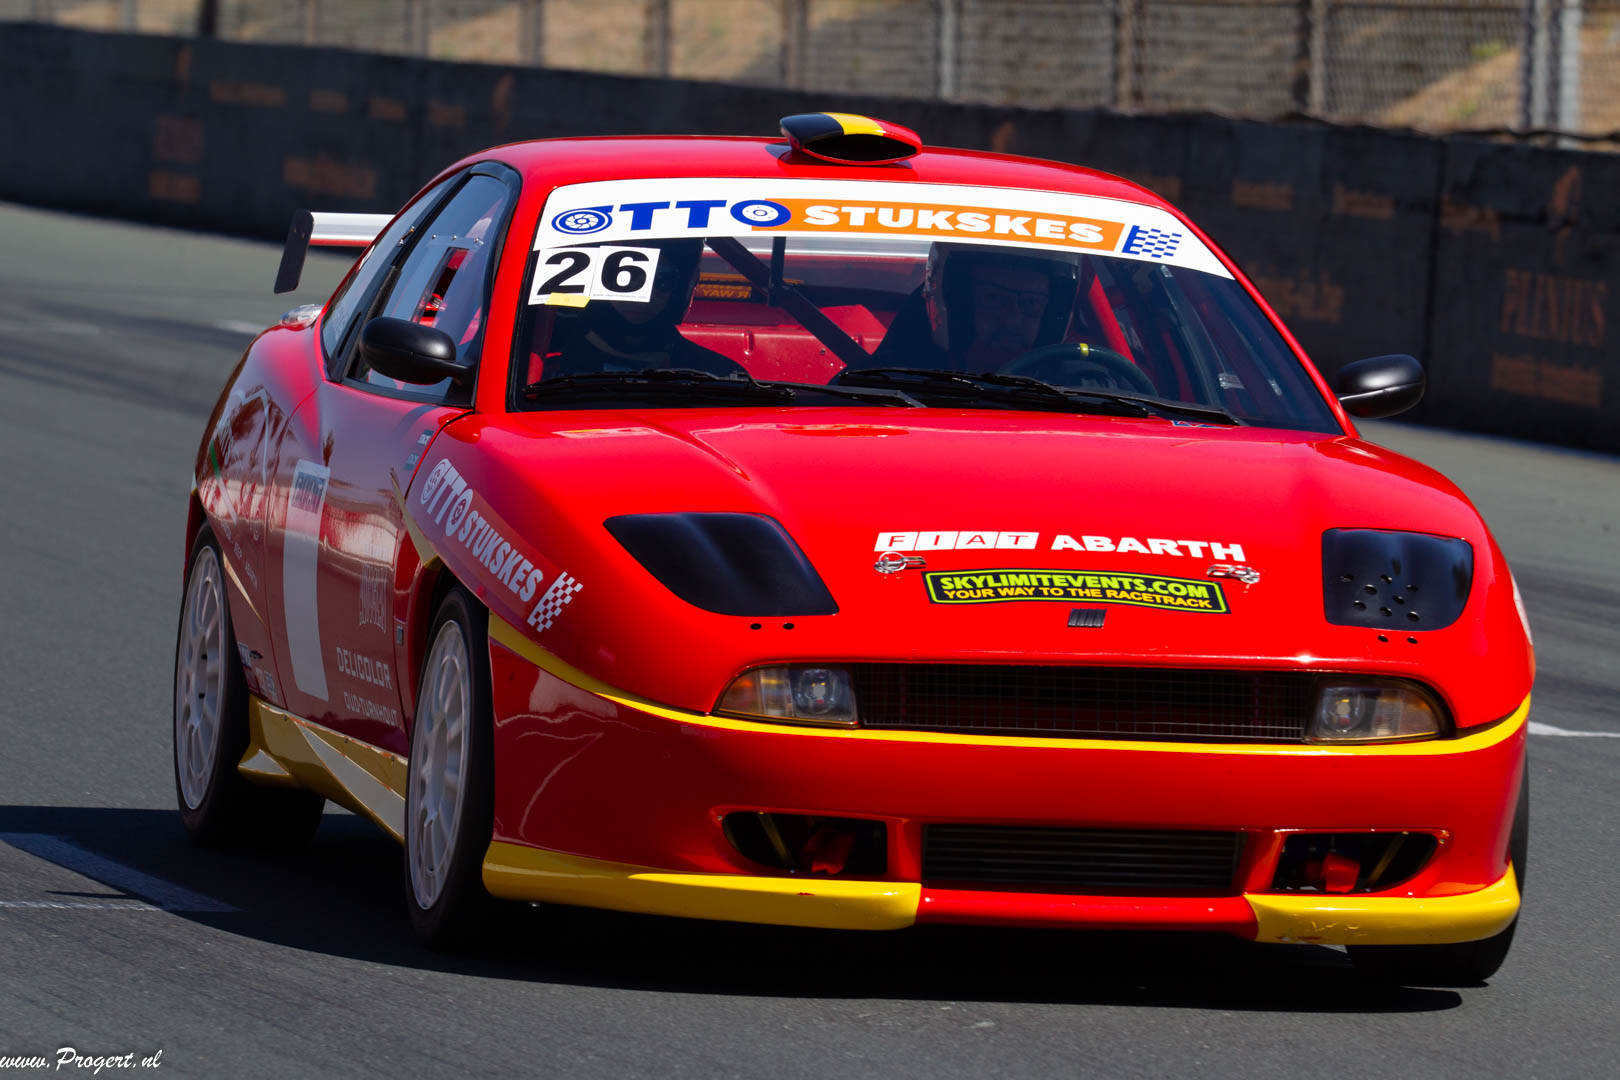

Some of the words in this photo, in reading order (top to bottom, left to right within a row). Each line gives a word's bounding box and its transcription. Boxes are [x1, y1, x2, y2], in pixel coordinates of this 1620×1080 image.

[551, 199, 792, 235] OTTO
[804, 205, 1104, 243] STUKSKES
[536, 250, 650, 295] 26
[420, 458, 474, 536] OTTO
[458, 510, 544, 602] STUKSKES
[880, 533, 1036, 549] FIAT
[1051, 535, 1246, 562] ABARTH
[940, 574, 1209, 599] SKYLIMITEVENTS.COM
[944, 588, 995, 600] YOUR
[996, 586, 1036, 597] WAY
[1039, 587, 1064, 597] TO
[1070, 588, 1103, 598] THE
[1110, 589, 1213, 609] RACETRACK
[336, 647, 392, 690] DELICOLOR
